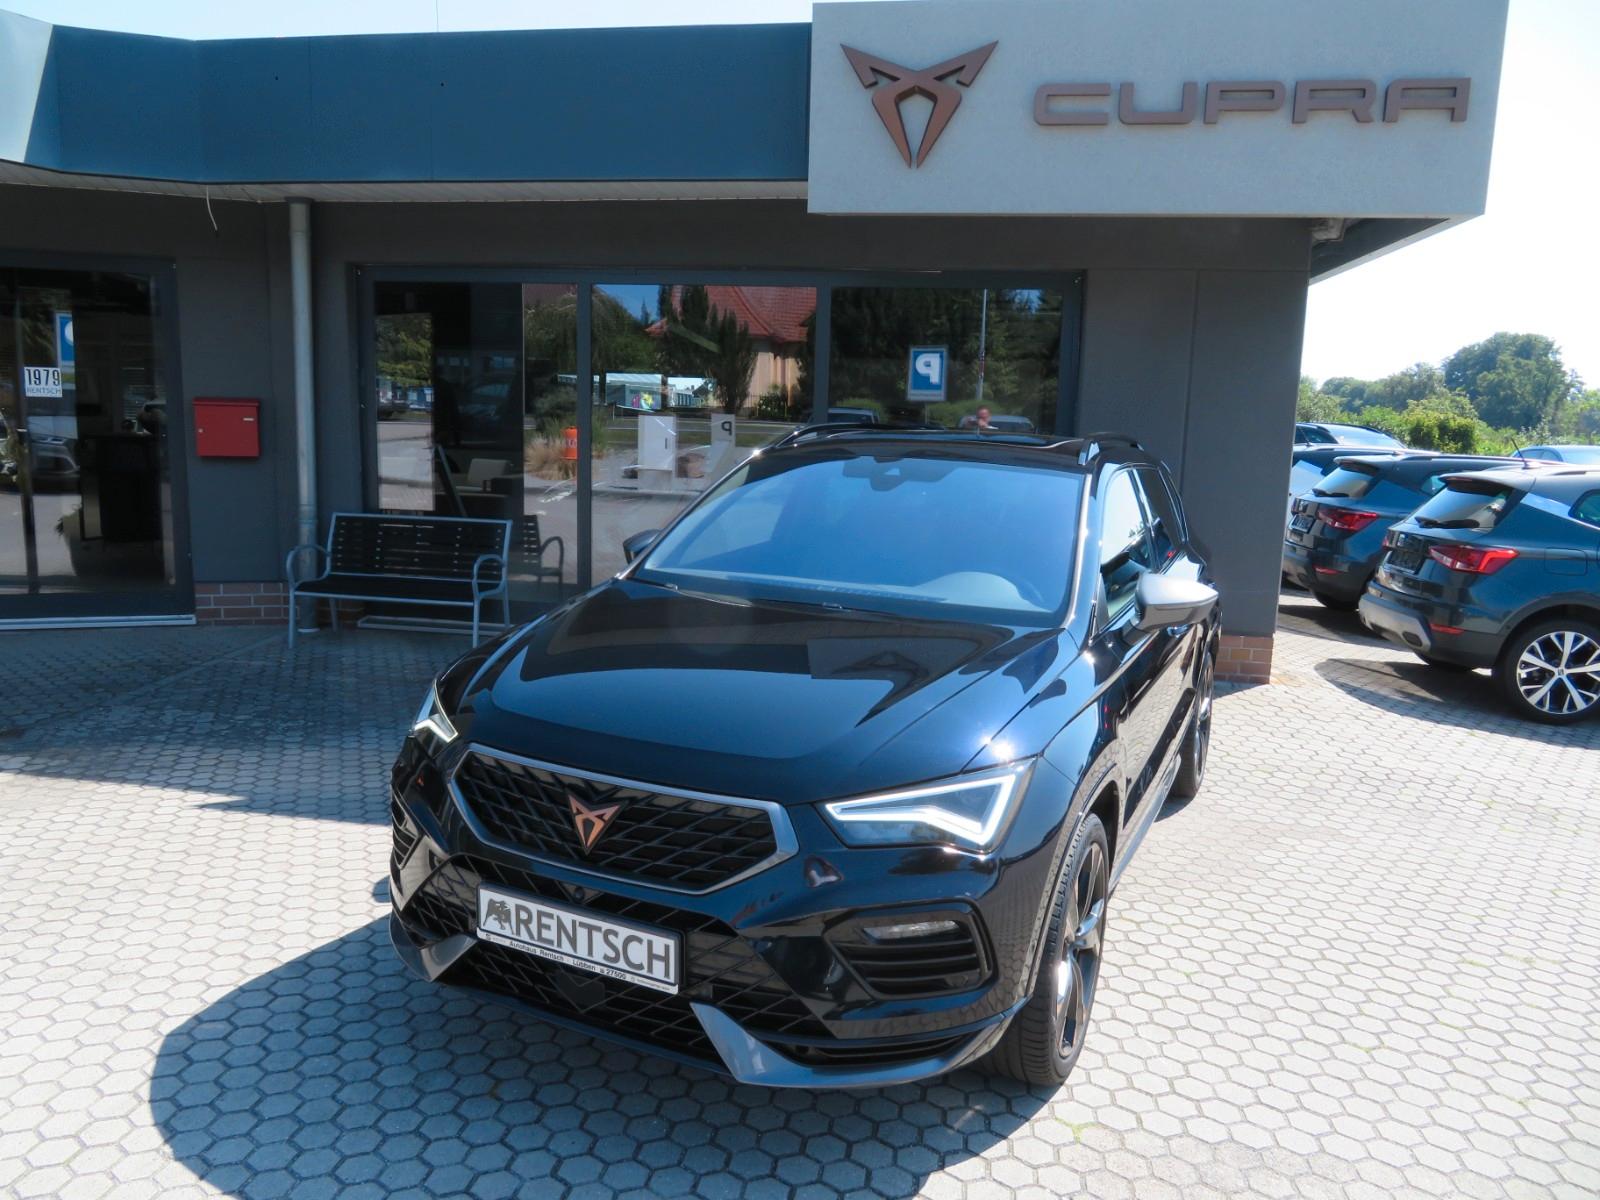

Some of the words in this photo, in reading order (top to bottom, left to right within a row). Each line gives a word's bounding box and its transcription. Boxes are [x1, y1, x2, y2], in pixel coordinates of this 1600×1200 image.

[1033, 77, 1472, 126] CUPRA
[25, 368, 60, 386] 1979
[509, 941, 537, 954] Autohaus
[539, 949, 564, 962] Rentsch
[572, 959, 596, 971] Lübben
[514, 903, 671, 980] RENTSCH
